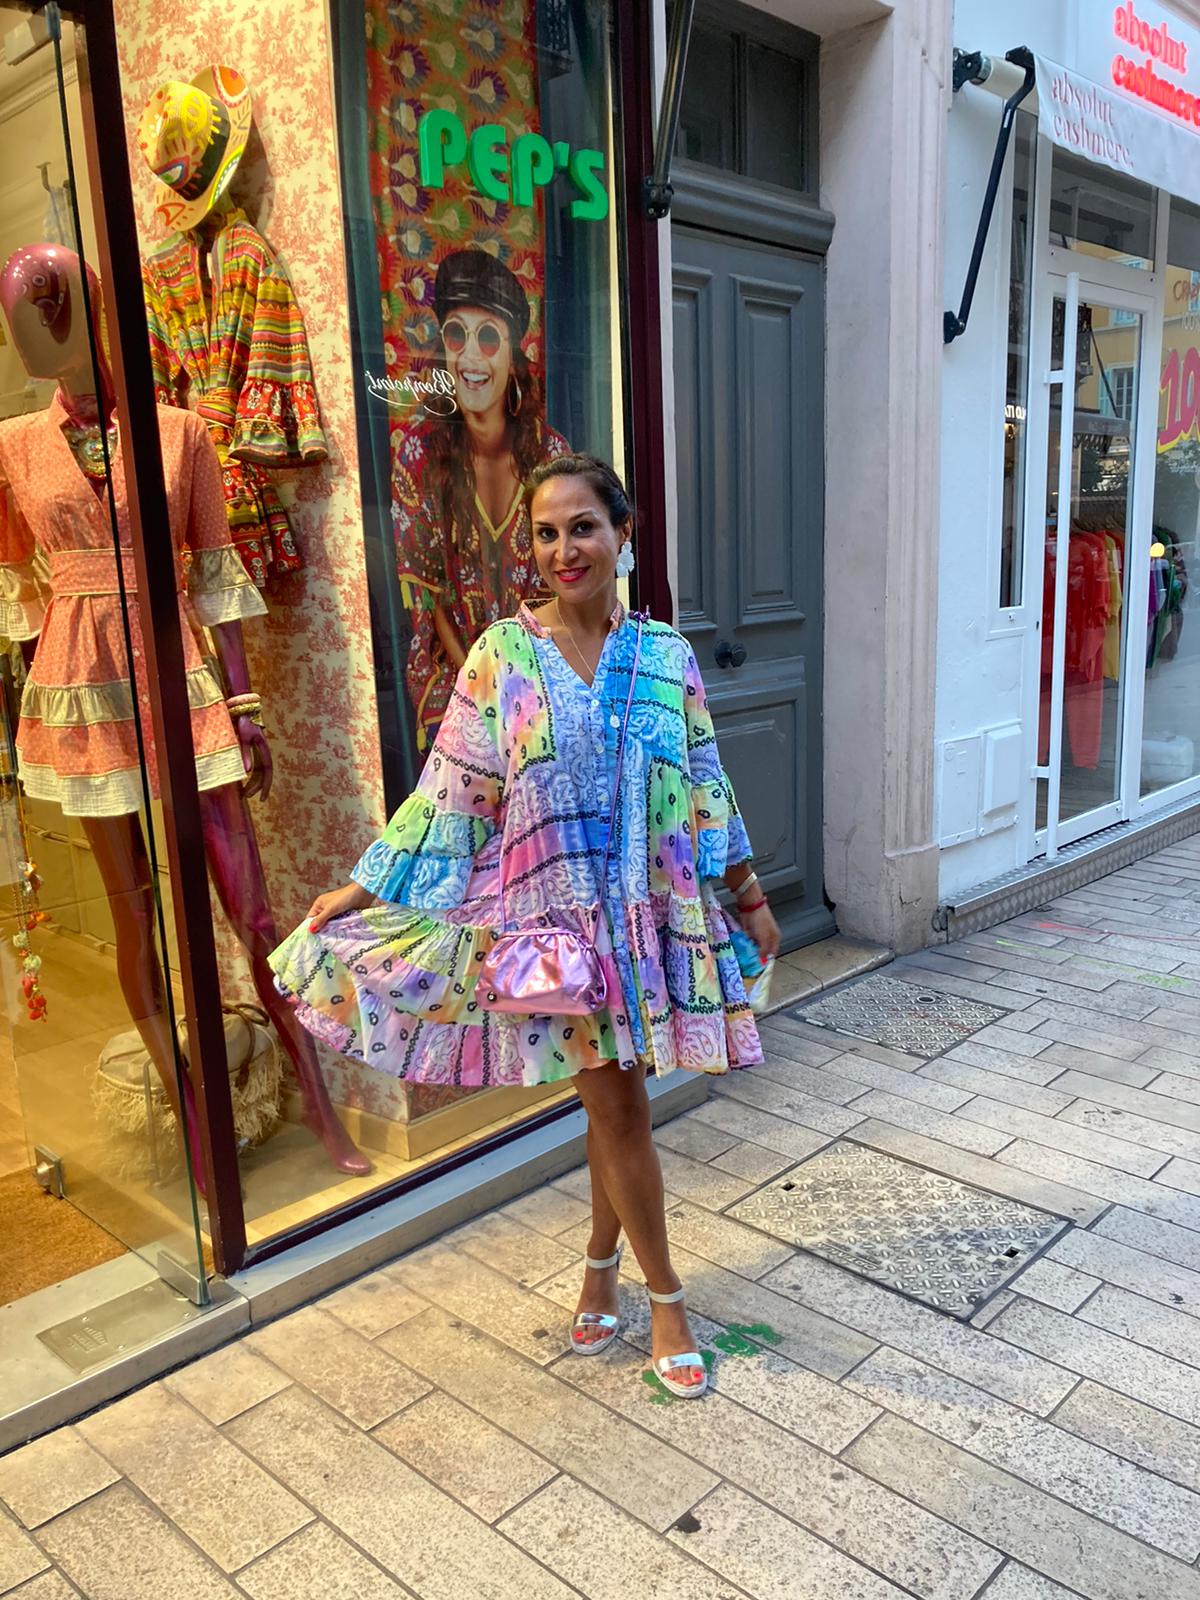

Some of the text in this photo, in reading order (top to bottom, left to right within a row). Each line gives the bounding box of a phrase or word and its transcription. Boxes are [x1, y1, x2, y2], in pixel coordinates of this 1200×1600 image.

[1114, 1, 1187, 74] absolut
[1052, 72, 1114, 127] absolut
[418, 108, 609, 221] PEP'S
